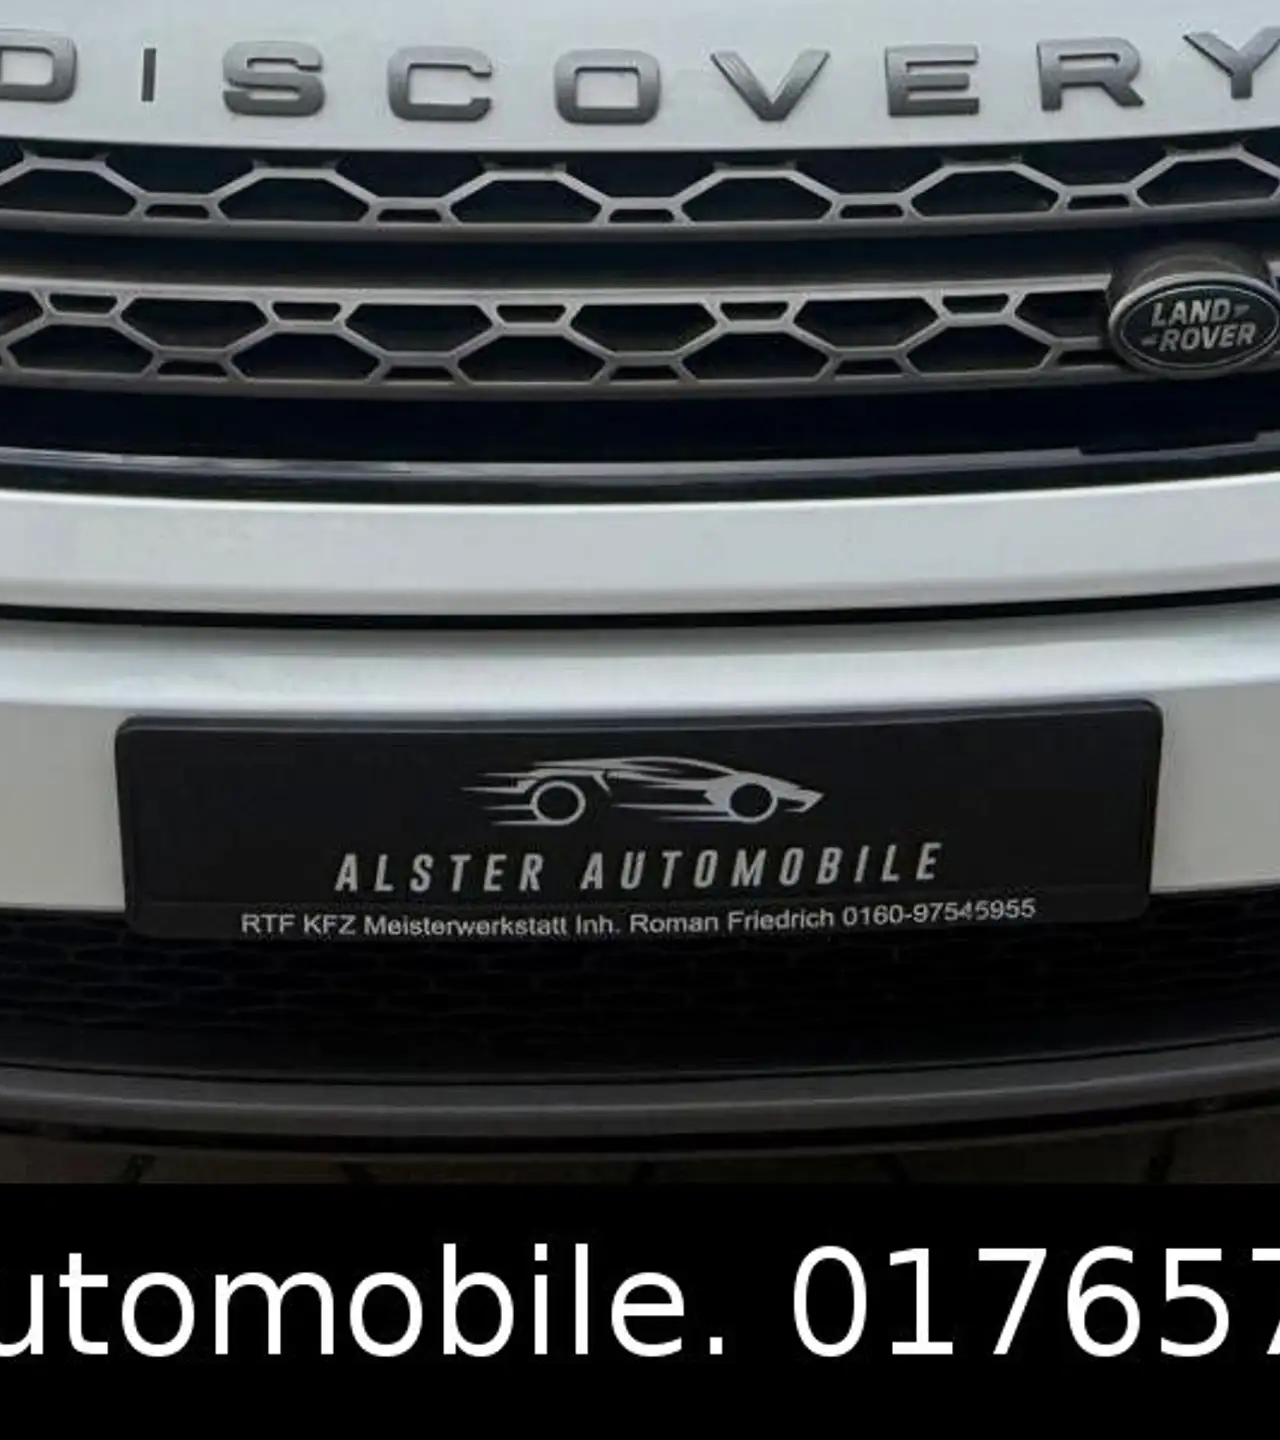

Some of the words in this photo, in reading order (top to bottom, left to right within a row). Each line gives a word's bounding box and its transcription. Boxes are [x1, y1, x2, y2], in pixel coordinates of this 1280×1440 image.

[1151, 299, 1230, 327] LAND
[1159, 324, 1256, 352] ROVER
[334, 853, 544, 893] ALSTER
[580, 842, 942, 891] AUTOMOBILE
[240, 913, 296, 934] RTF
[303, 914, 357, 936] KFZ
[363, 914, 568, 937] Meisterwerkstatt
[576, 914, 621, 935] Inh.
[629, 913, 719, 934] Roman
[727, 909, 834, 931] Friedrich
[842, 897, 1037, 927] 0160-97545955
